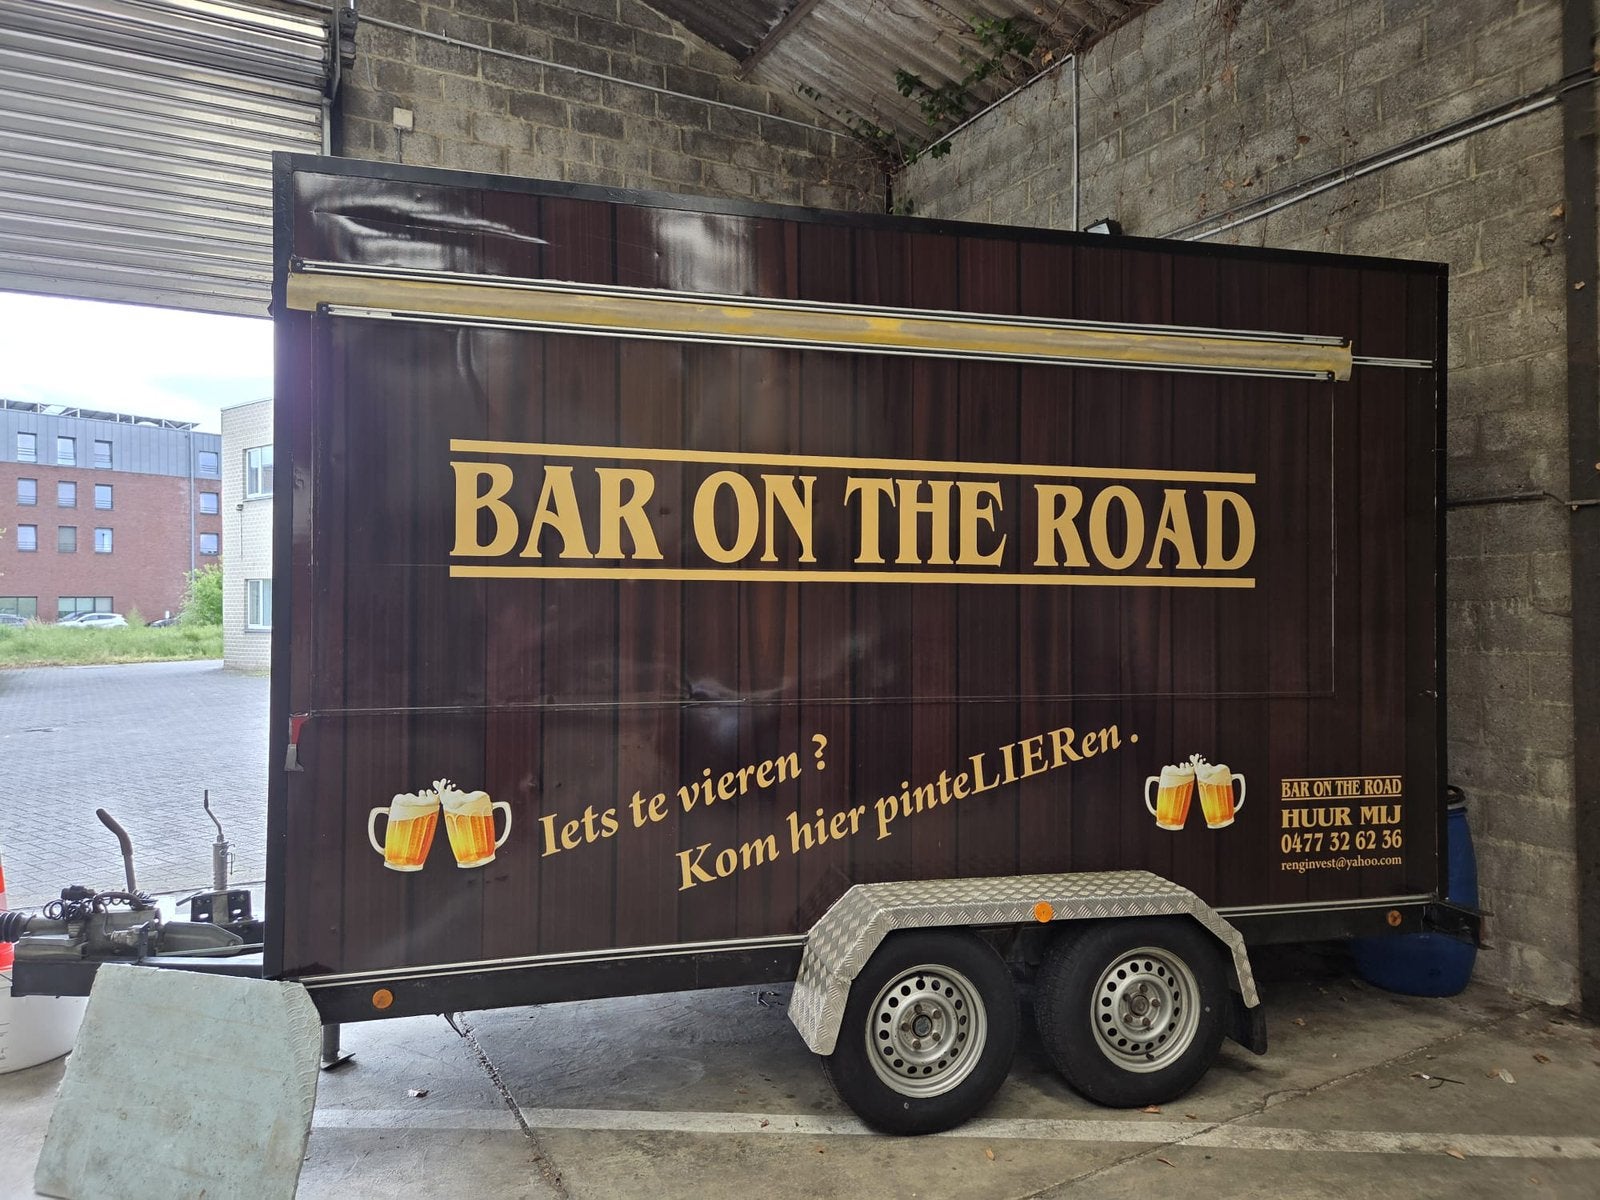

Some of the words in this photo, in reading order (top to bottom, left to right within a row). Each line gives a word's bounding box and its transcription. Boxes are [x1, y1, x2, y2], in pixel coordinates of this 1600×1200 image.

[450, 461, 664, 560] BAR
[693, 471, 817, 564] ON
[844, 477, 1007, 567] THE
[1034, 484, 1256, 570] ROAD
[539, 806, 619, 857] Iets
[631, 791, 668, 828] te
[678, 751, 801, 812] vieren
[811, 733, 828, 770] ?
[1281, 781, 1310, 798] BAR
[1313, 780, 1332, 797] ON
[1335, 780, 1361, 796] THE
[1364, 778, 1402, 795] ROAD
[677, 834, 780, 891] Kom
[787, 804, 866, 854] hier
[875, 725, 1121, 840] pinteLIERen
[1281, 807, 1353, 828] HUUR
[1360, 805, 1402, 825] MIJ
[1281, 832, 1324, 854] 0477
[1330, 831, 1350, 851] 32
[1355, 830, 1376, 850] 62
[1382, 829, 1402, 849] 36
[1281, 855, 1402, 873] renginvest@yahoo.com
